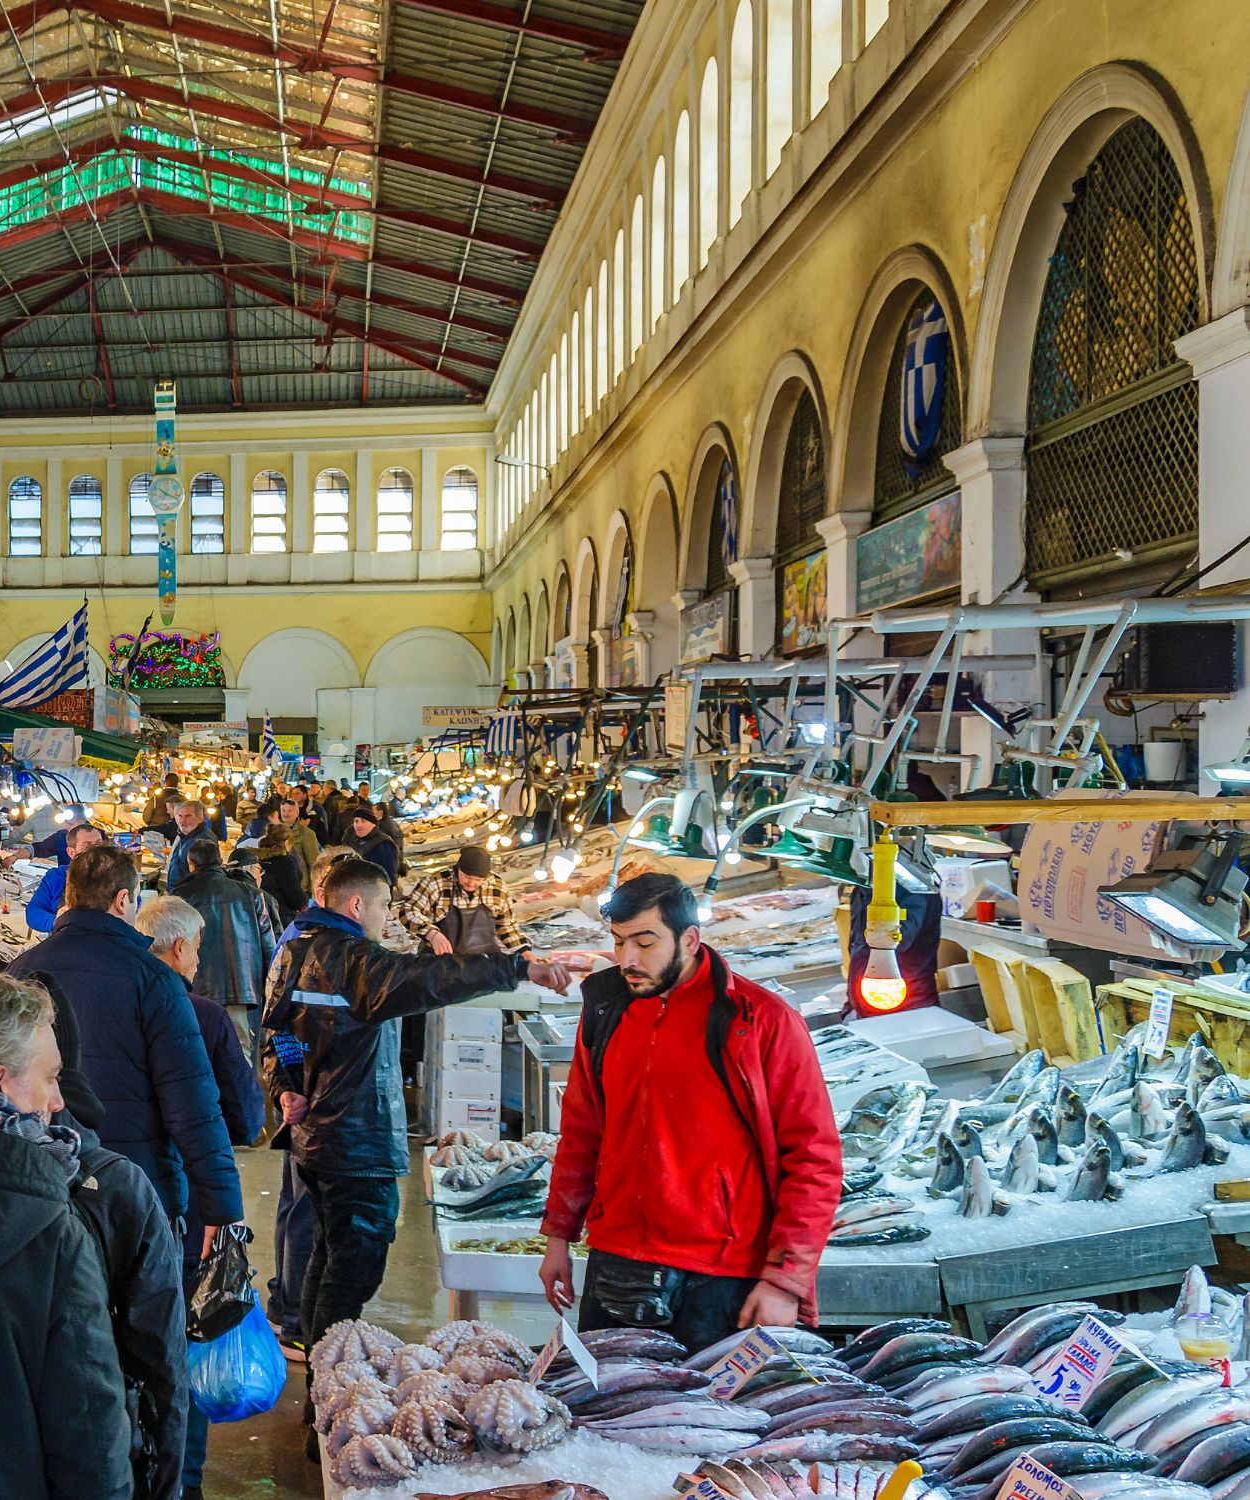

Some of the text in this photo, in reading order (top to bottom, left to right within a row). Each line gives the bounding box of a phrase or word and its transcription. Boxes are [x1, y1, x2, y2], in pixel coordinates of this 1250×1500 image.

[1044, 846, 1063, 920] ΙΧΘΥΟΠΩΛΕΙΟ
[1014, 1480, 1047, 1500] ΦΡΕΣΚ
[1016, 1456, 1066, 1496] ΣΟΛΟΜΟΣ
